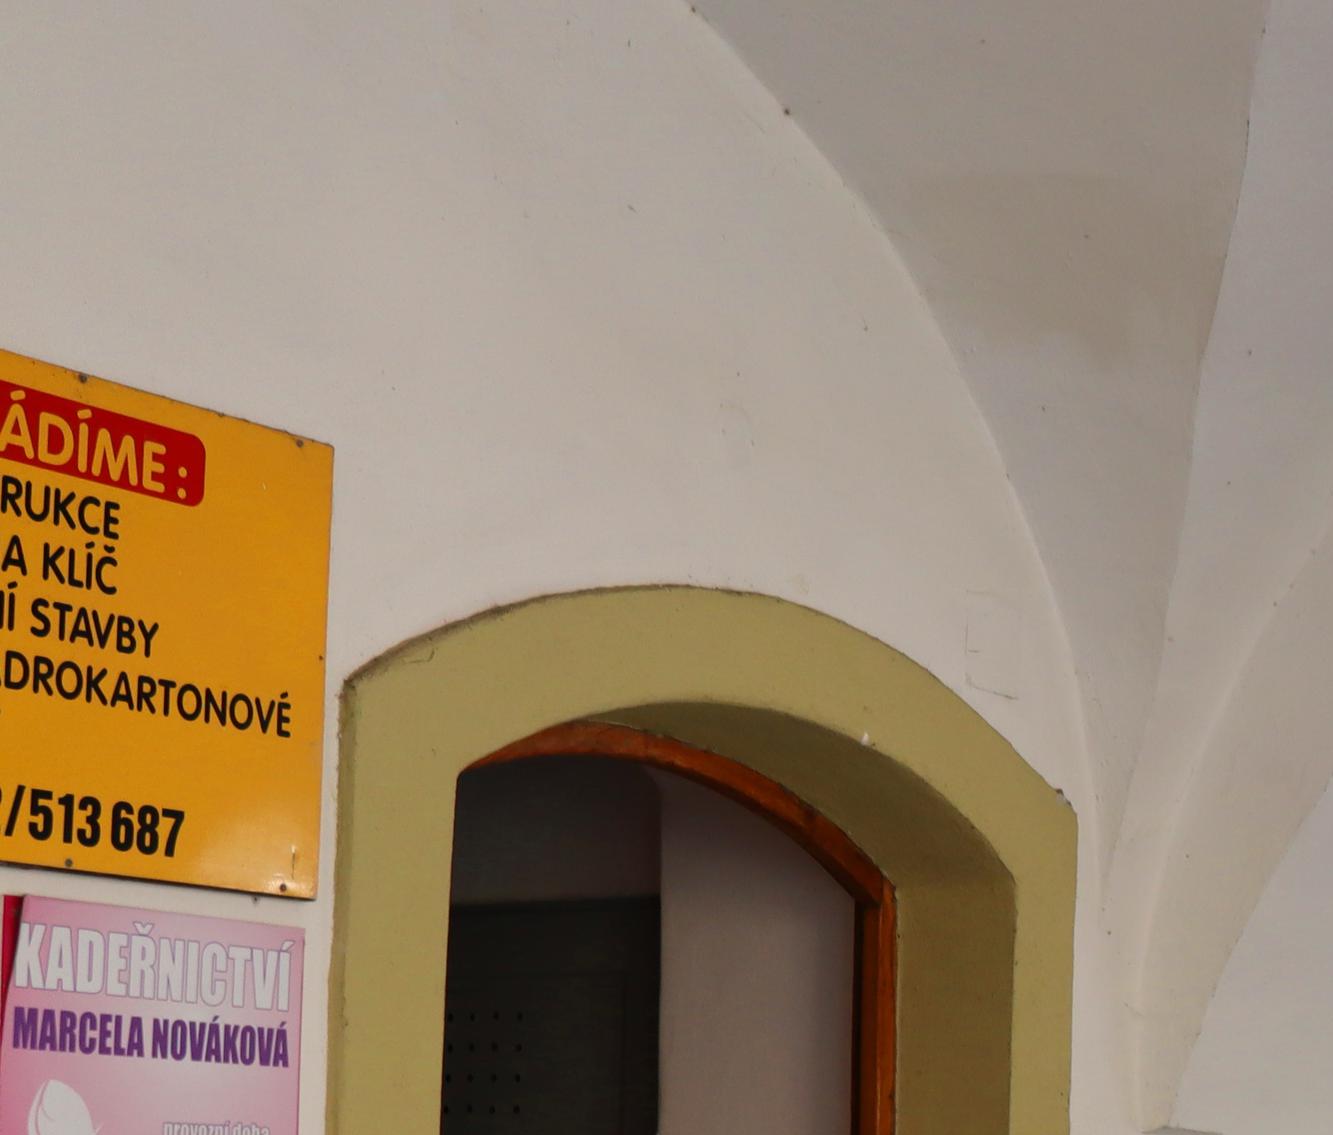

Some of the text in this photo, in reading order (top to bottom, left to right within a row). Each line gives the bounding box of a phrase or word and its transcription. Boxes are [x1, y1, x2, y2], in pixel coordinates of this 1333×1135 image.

[1, 475, 120, 540] RUKCE
[43, 540, 117, 595] KLÍČ
[31, 599, 159, 658] STAVBY
[0, 650, 292, 738] DROKARTONOVÉ
[0, 784, 185, 857] /513 687
[14, 921, 294, 1012] KADEŘNICTVÍ
[13, 1006, 289, 1068] MARCELA NOVÁKOVÁ
